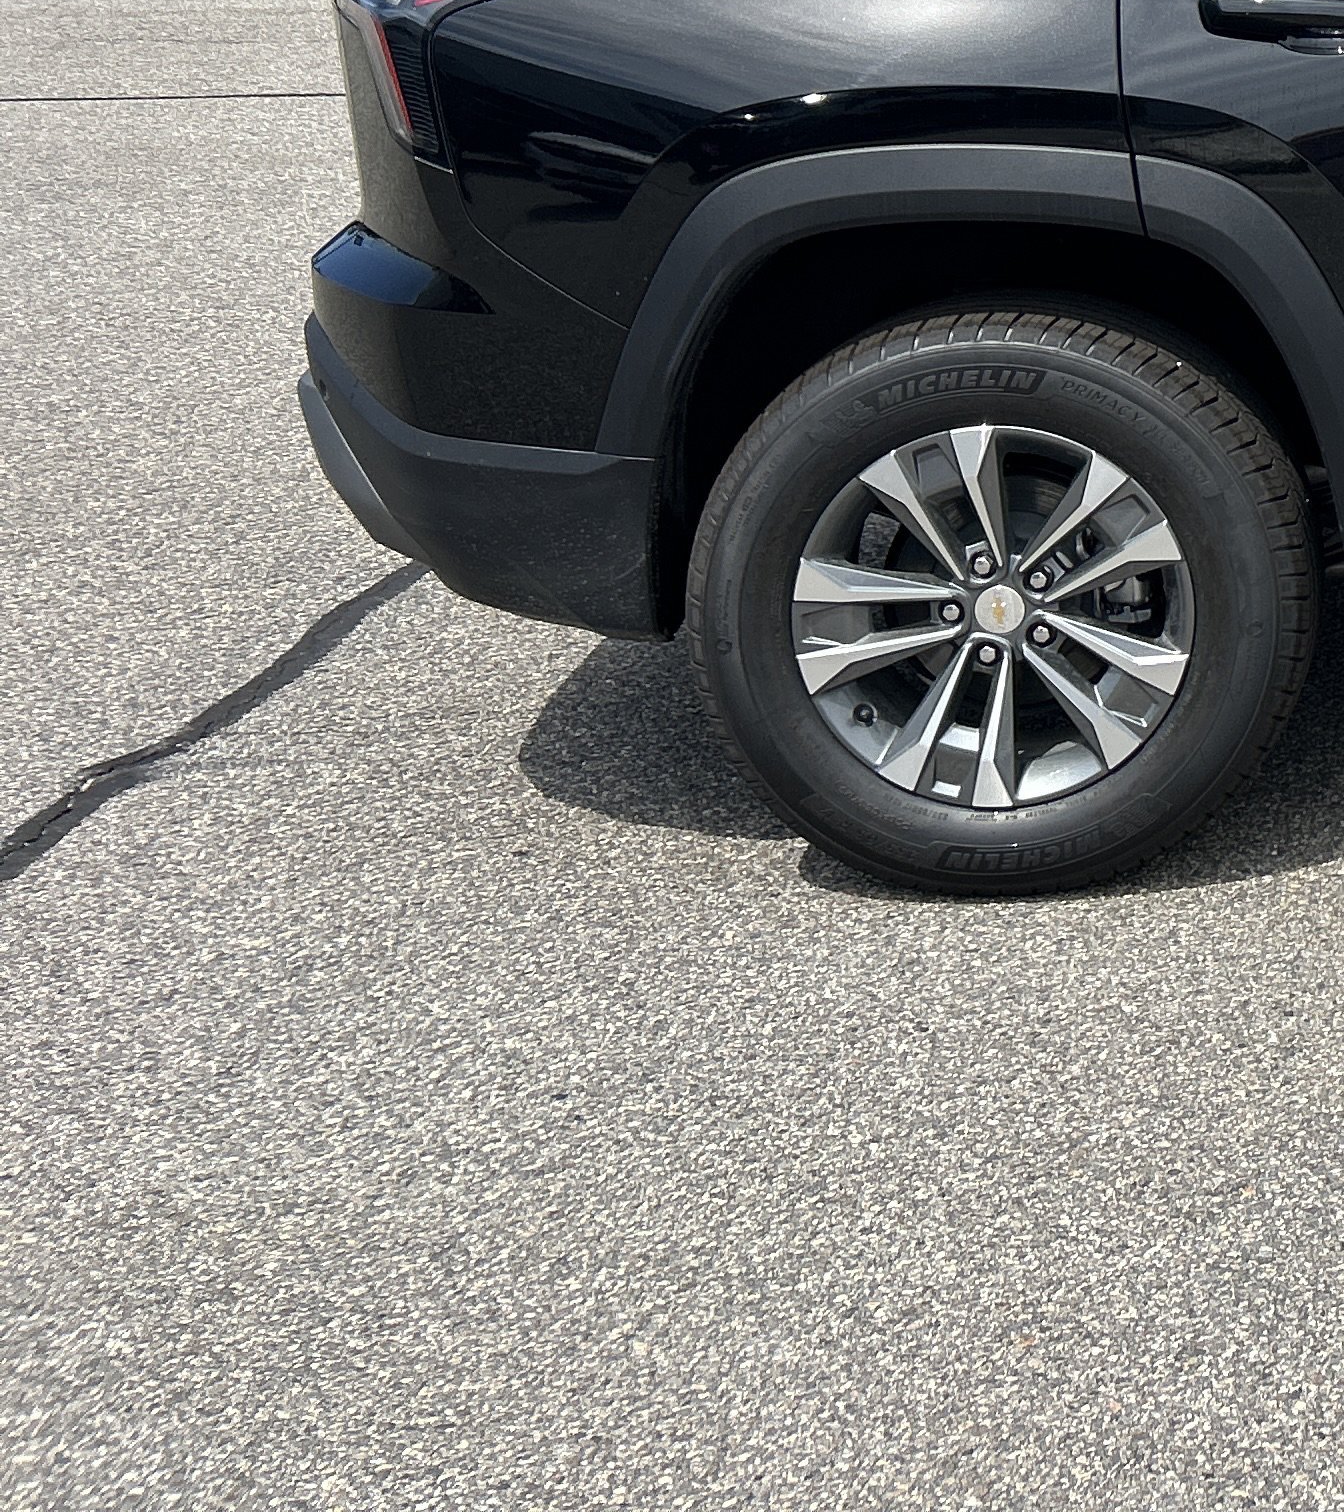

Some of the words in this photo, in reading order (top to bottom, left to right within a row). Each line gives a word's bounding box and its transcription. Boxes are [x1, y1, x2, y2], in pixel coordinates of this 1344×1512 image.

[877, 369, 1038, 407] MICHELIN
[1061, 380, 1145, 425] PRIMACY
[949, 825, 1101, 870] MICHELIN
